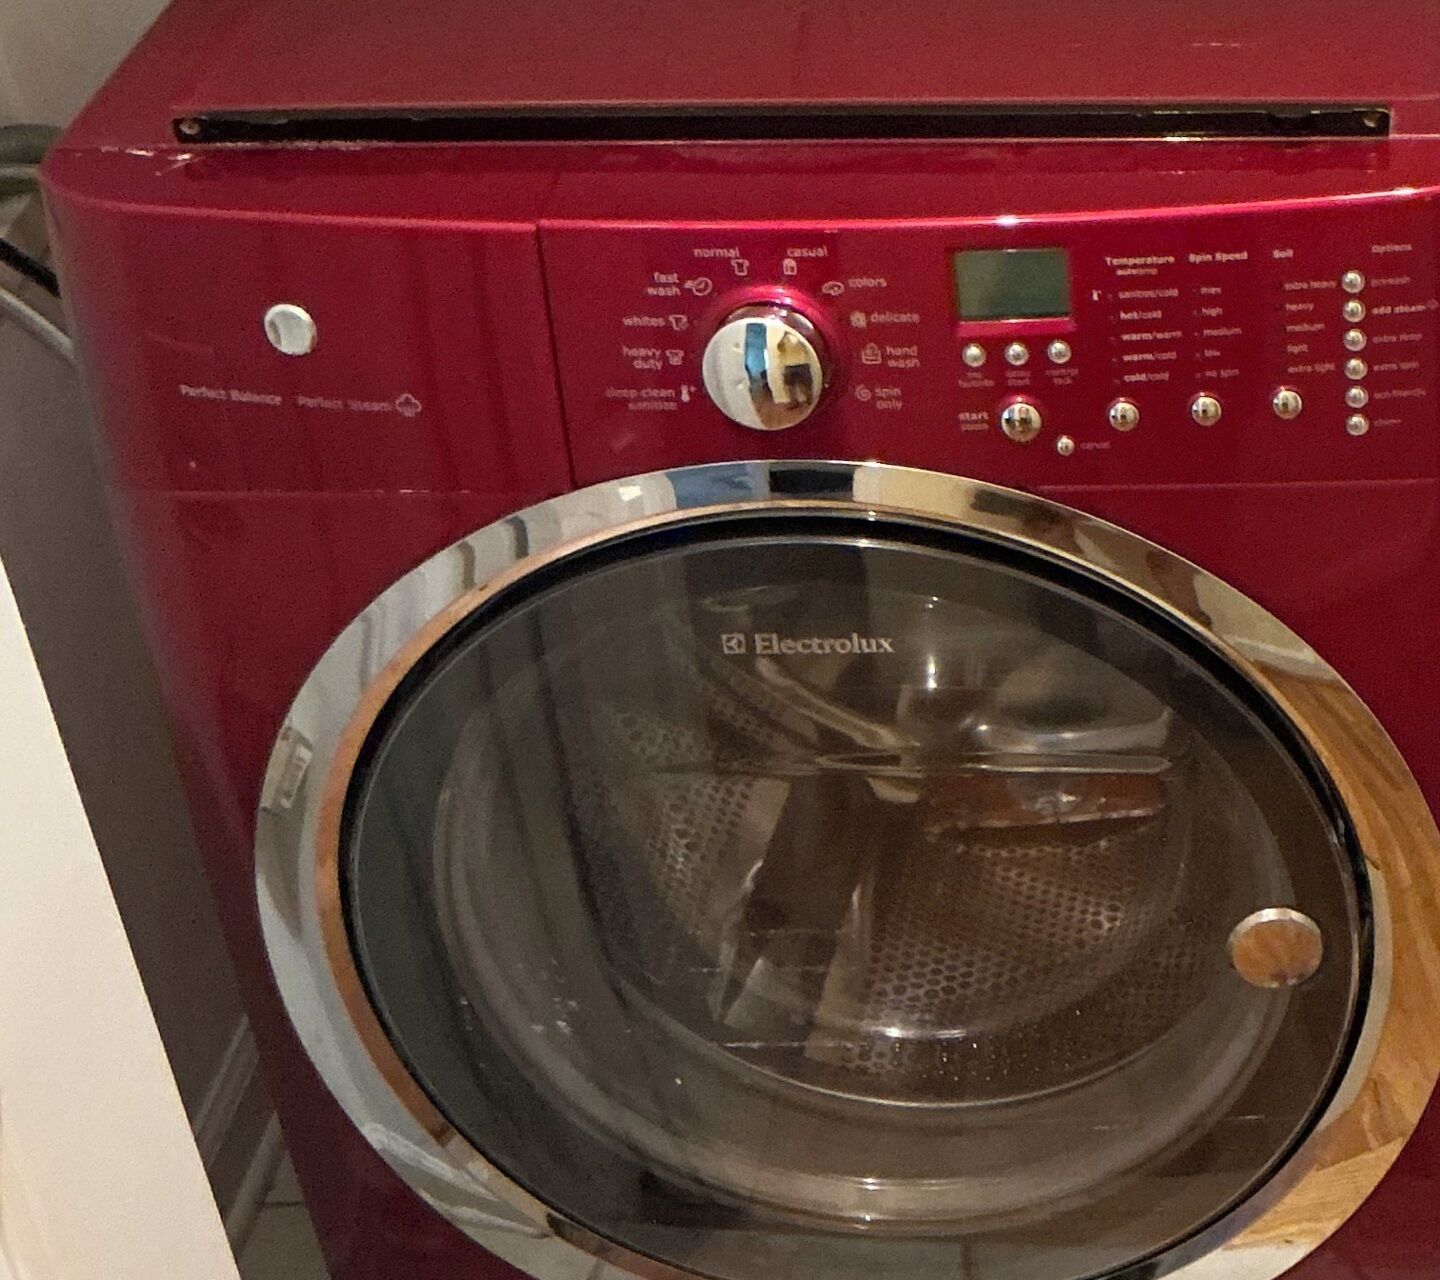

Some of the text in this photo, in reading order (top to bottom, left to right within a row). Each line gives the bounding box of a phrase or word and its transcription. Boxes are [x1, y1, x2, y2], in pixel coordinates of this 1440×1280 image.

[694, 246, 741, 258] normal
[786, 245, 829, 257] casual
[1105, 256, 1175, 266] Temperature
[653, 271, 680, 284] fast
[848, 277, 888, 288] colors
[646, 285, 681, 296] wash
[870, 312, 920, 323] delicate
[622, 345, 661, 359] heavy
[886, 345, 918, 356] hand
[633, 359, 663, 371] duty
[887, 357, 920, 368] wash
[874, 387, 902, 398] spin
[875, 399, 903, 410] only
[754, 631, 895, 655] Electrolux
